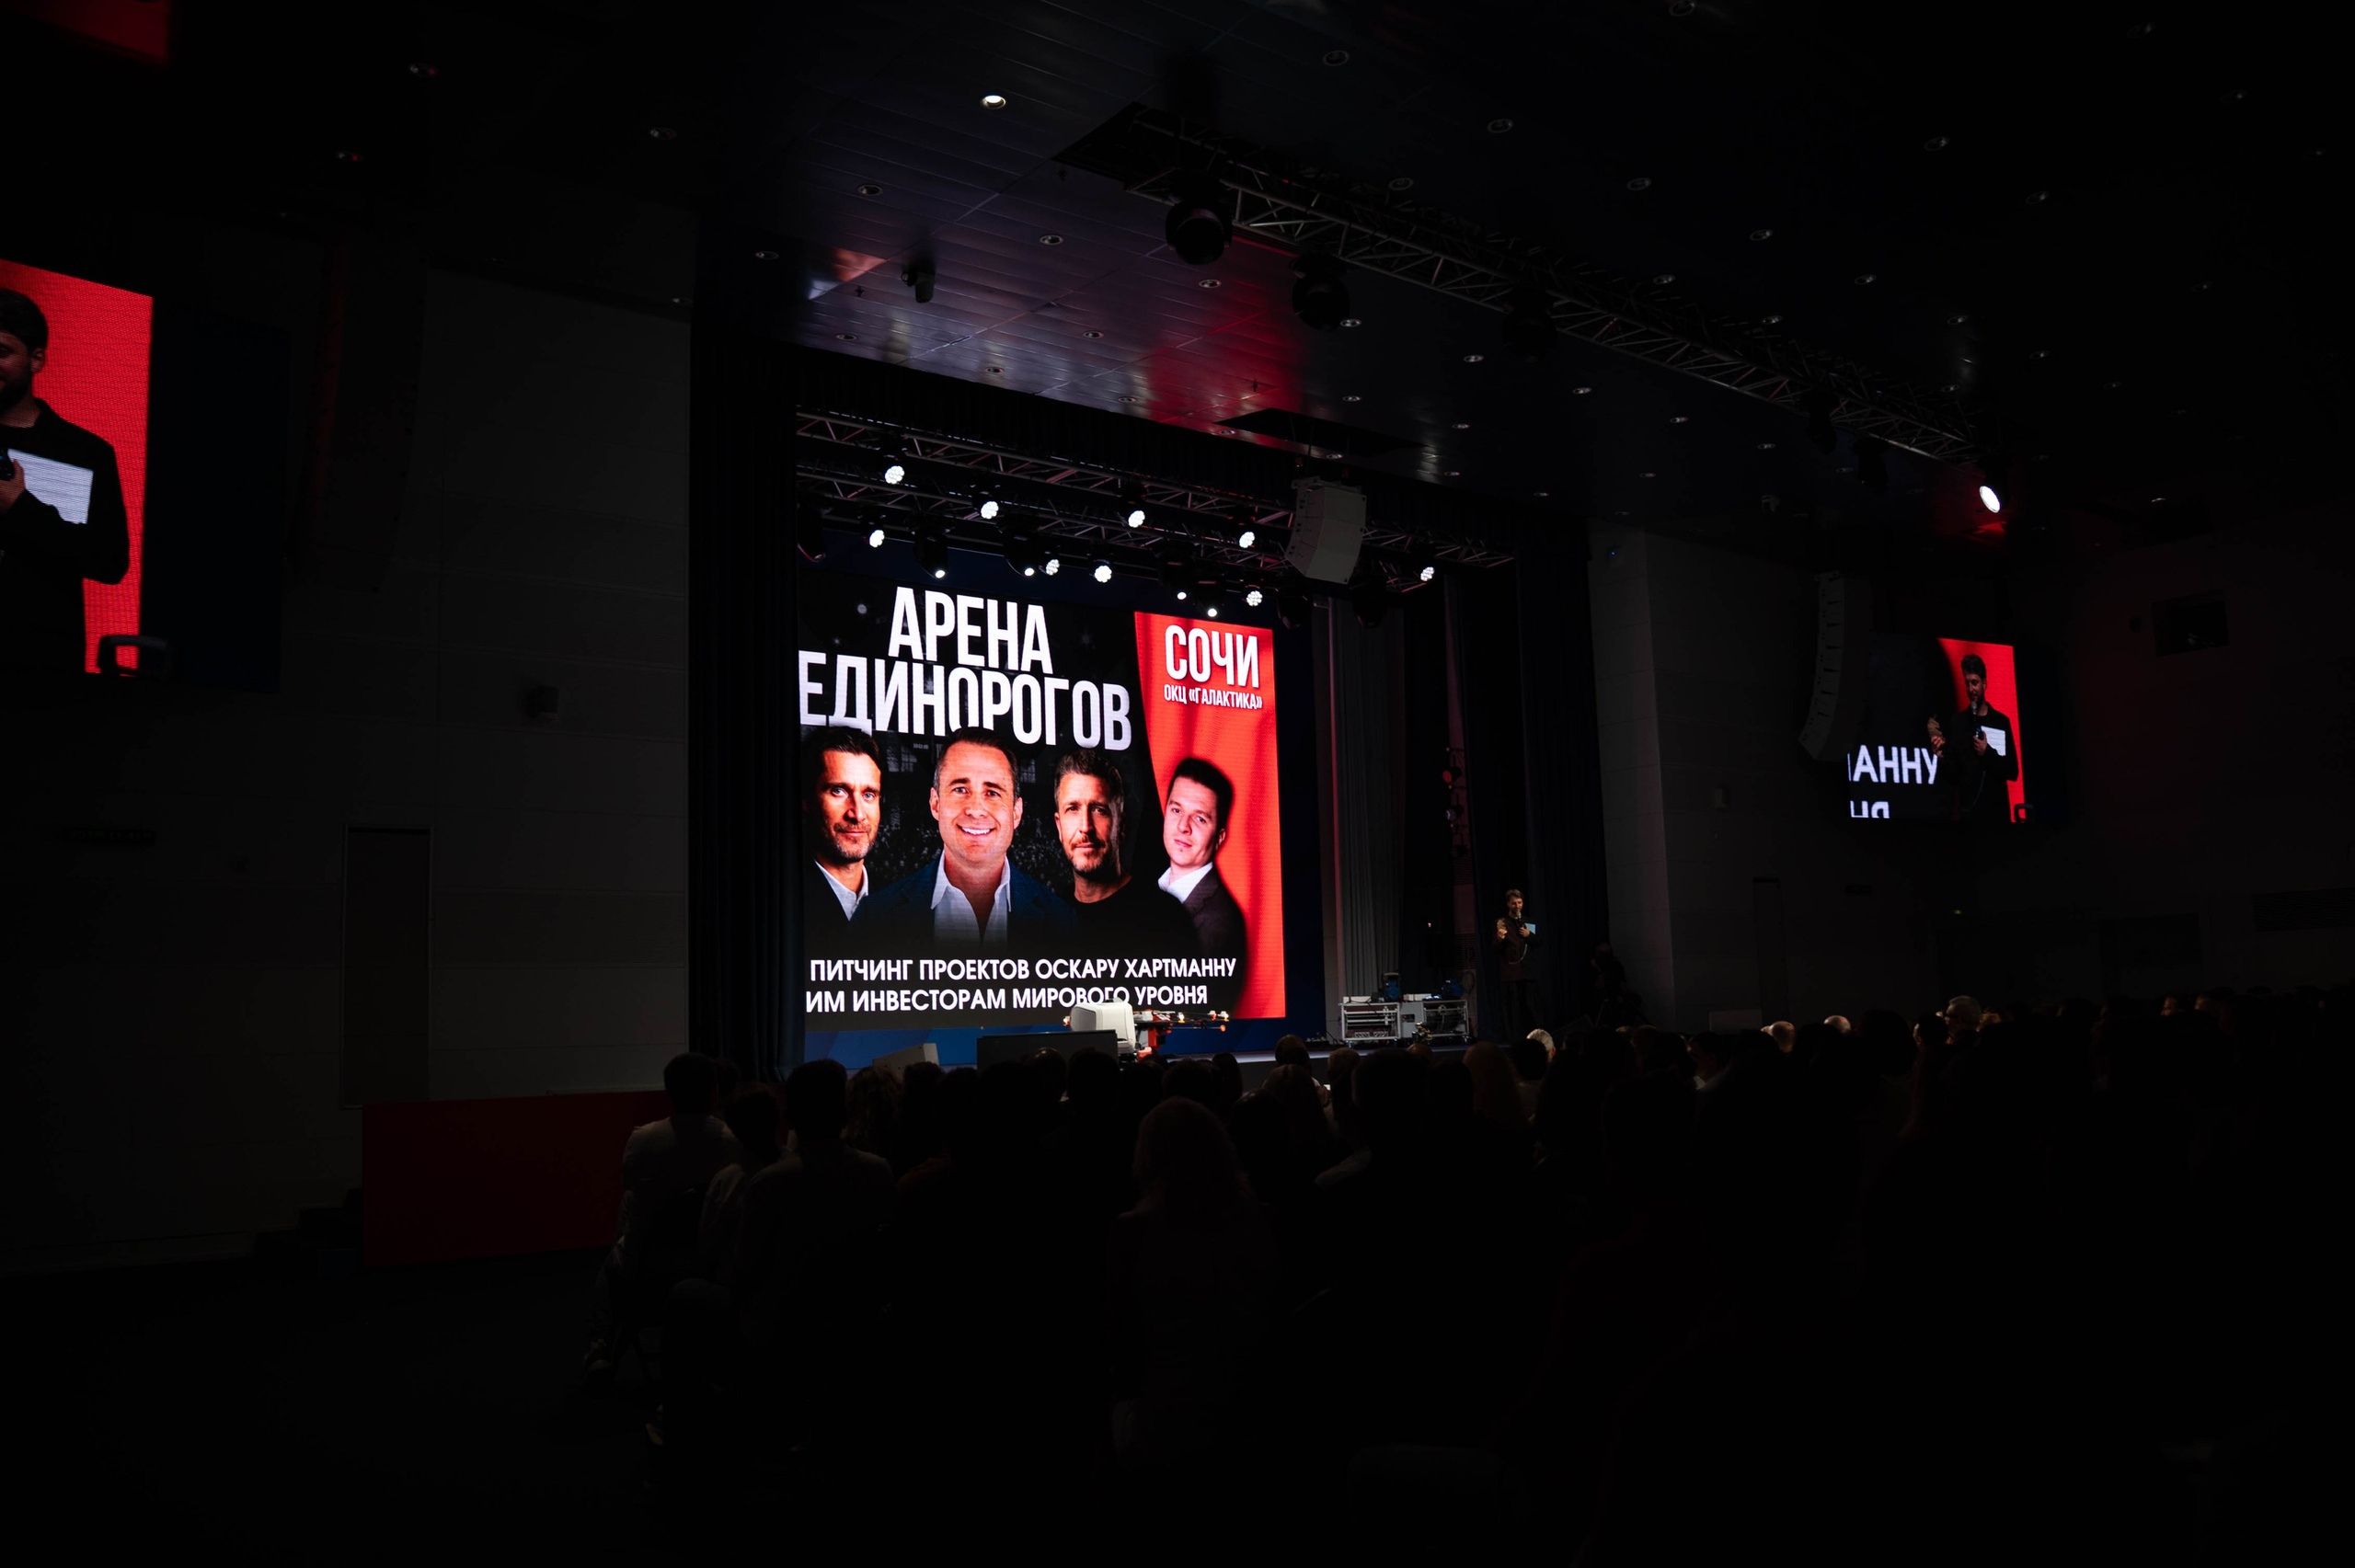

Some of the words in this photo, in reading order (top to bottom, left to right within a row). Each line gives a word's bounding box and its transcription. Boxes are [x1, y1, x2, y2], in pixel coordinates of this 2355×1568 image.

[888, 586, 1053, 674] АРЕНА
[1165, 624, 1260, 688] СОЧИ
[798, 649, 1132, 750] ЕДИНОРОГОВ
[1164, 683, 1188, 704] ОКЦ
[1189, 687, 1263, 710] «ГАЛАКТИКА»
[1847, 744, 1938, 784] АННУ
[810, 959, 913, 981] ПИТЧИНГ
[919, 958, 1029, 980] ПРОЕКТОВ
[1035, 958, 1120, 979] ОСКАРУ
[1124, 957, 1236, 978] ХАРТМАННУ
[853, 988, 1005, 1012] ИНВЕСТОРАМ
[1012, 986, 1130, 1009] МИРОВОГО
[1134, 985, 1208, 1005] УРОВНЯ
